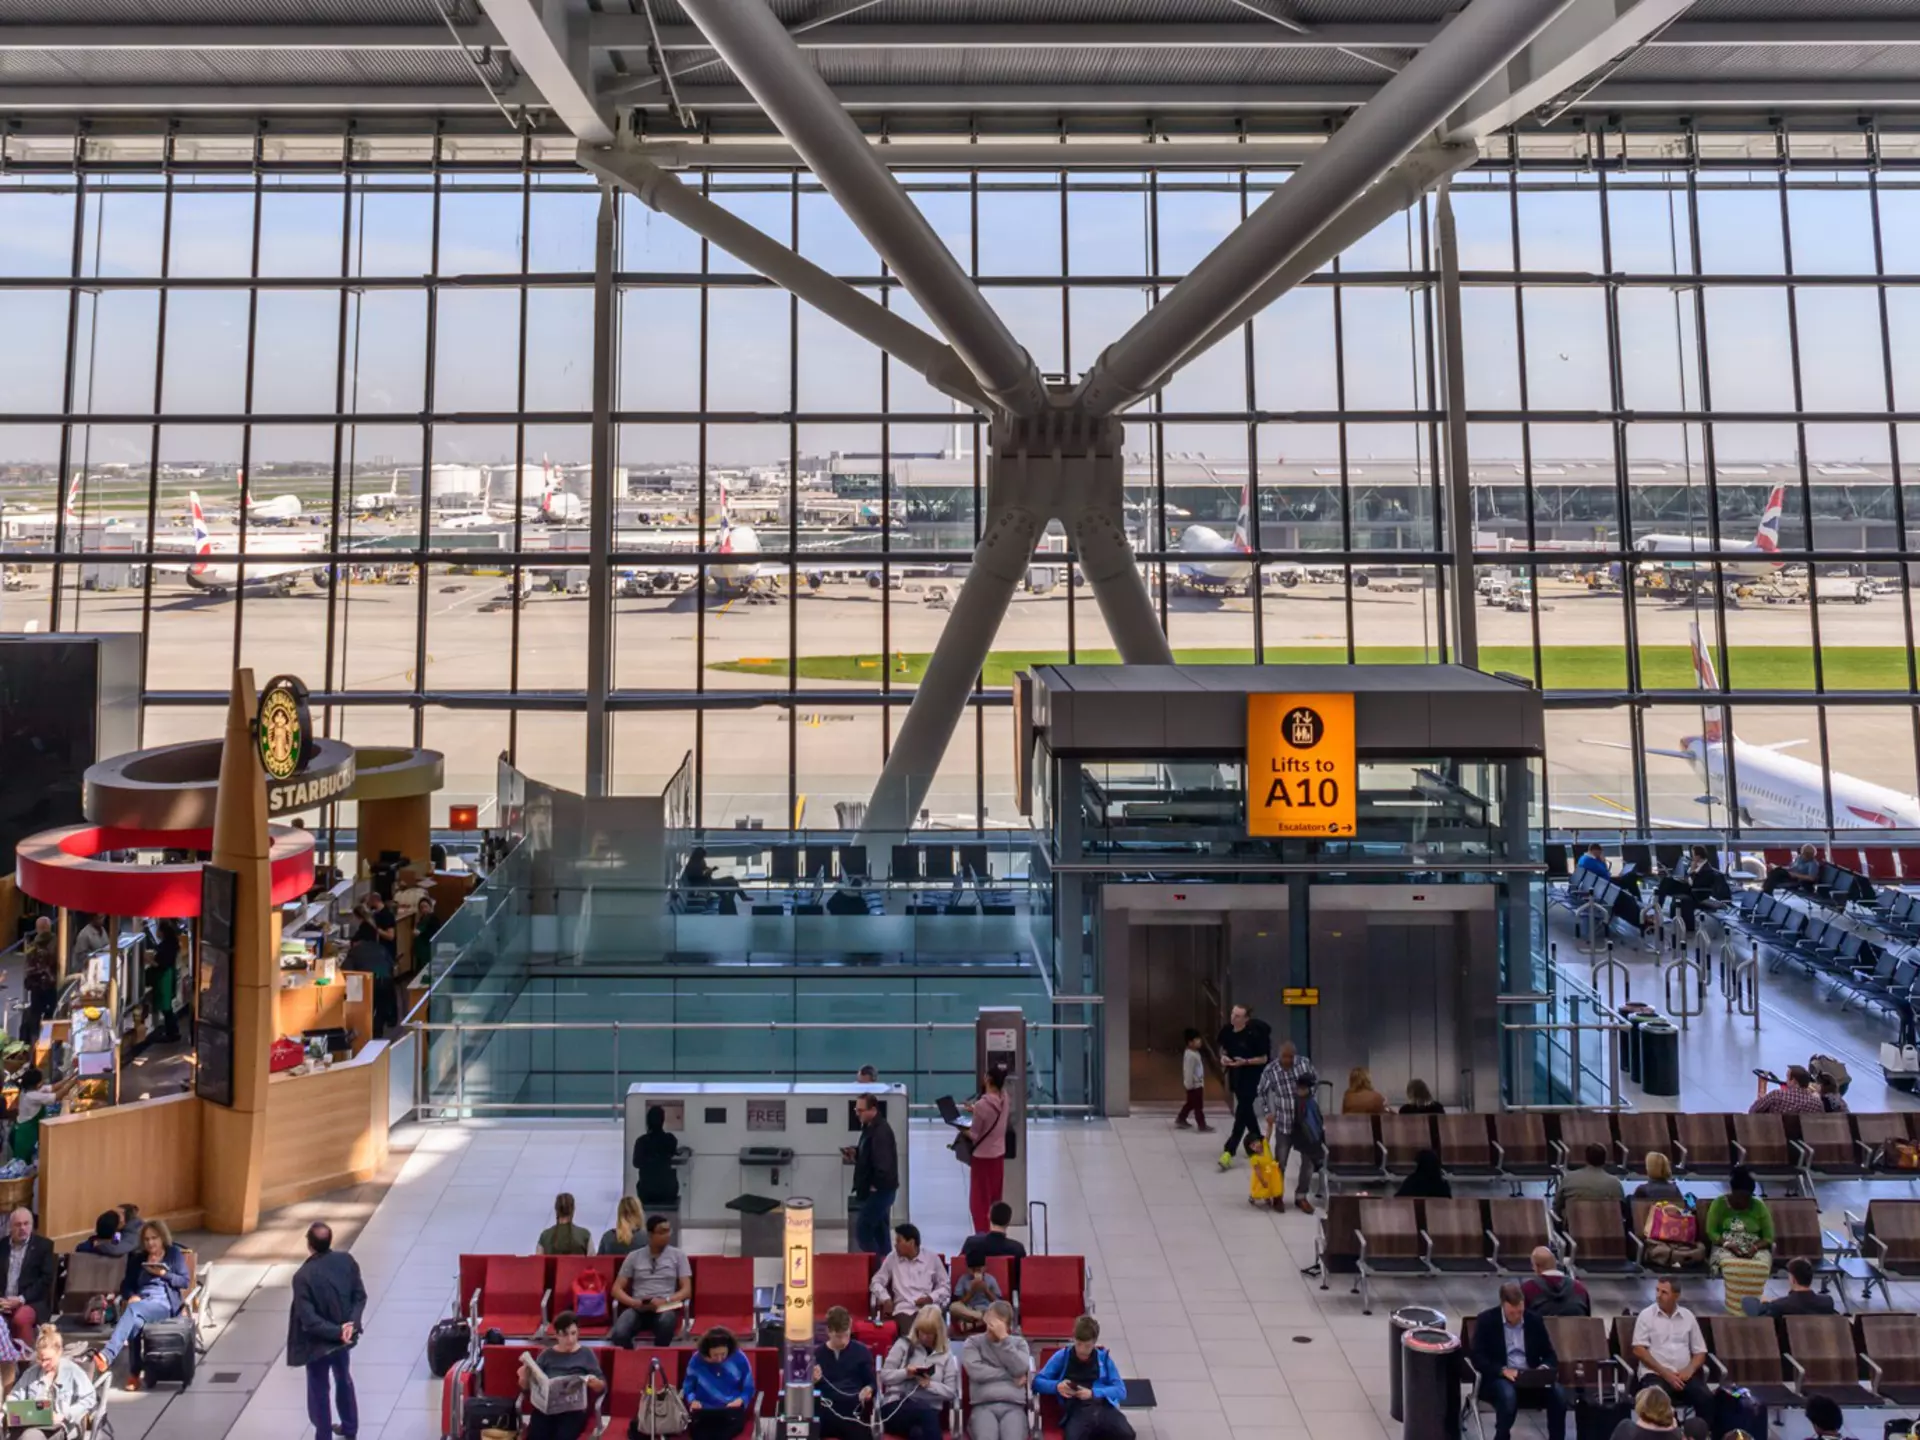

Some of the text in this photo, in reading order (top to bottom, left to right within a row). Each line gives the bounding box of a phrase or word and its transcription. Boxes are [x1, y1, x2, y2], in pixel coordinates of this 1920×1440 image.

[1271, 757, 1334, 772] Lifts to
[1265, 777, 1339, 808] A10
[1278, 822, 1326, 832] Escalators
[748, 1110, 784, 1123] FREE
